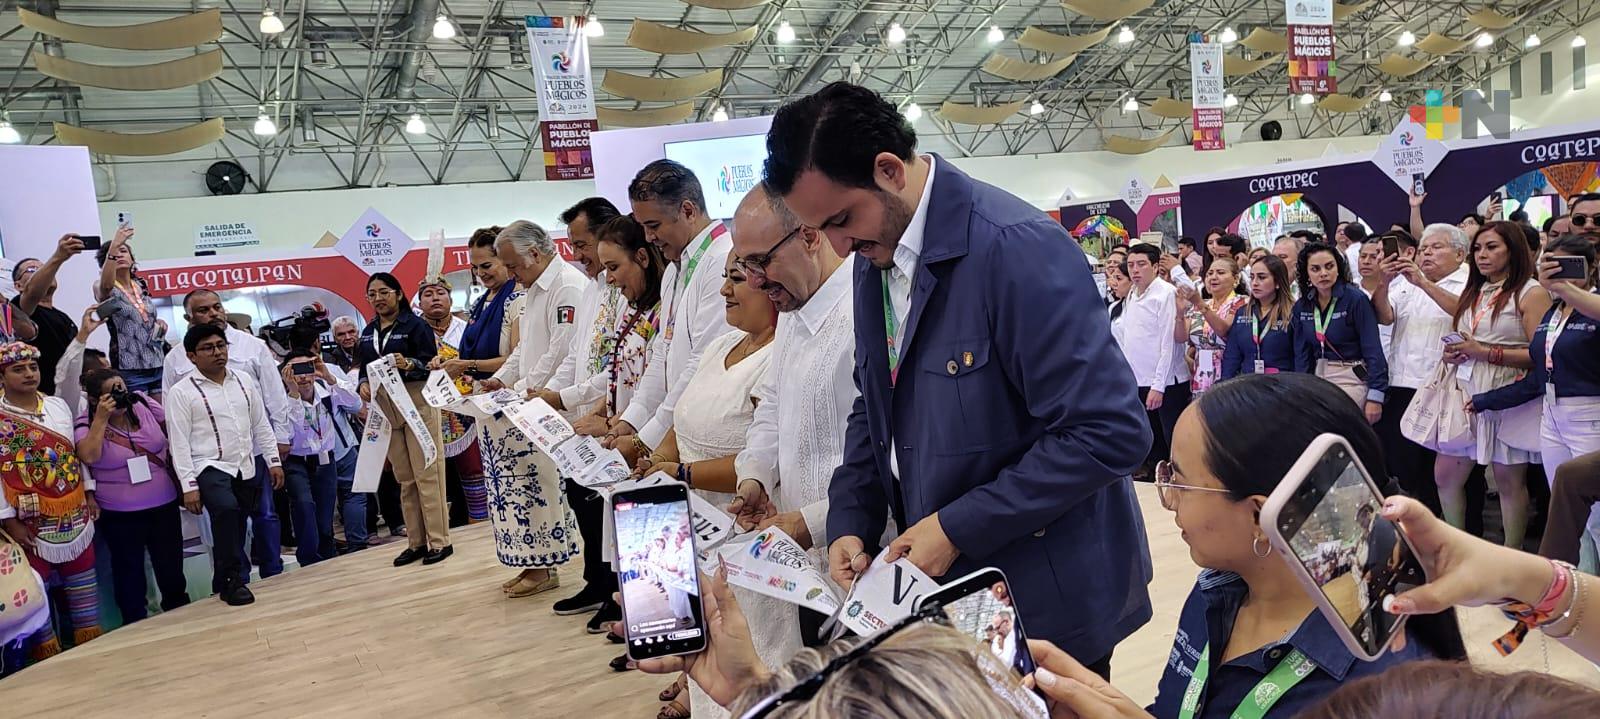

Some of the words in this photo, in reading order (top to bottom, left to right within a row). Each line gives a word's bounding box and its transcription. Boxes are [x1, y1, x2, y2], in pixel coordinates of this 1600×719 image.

[1294, 36, 1331, 46] PUEBLOS
[1294, 46, 1331, 56] MÁGICOS
[544, 79, 585, 90] PUEBLOS
[549, 122, 582, 130] PABELLÓN
[204, 223, 234, 231] SALIDA
[200, 228, 252, 238] EMERGENCIA
